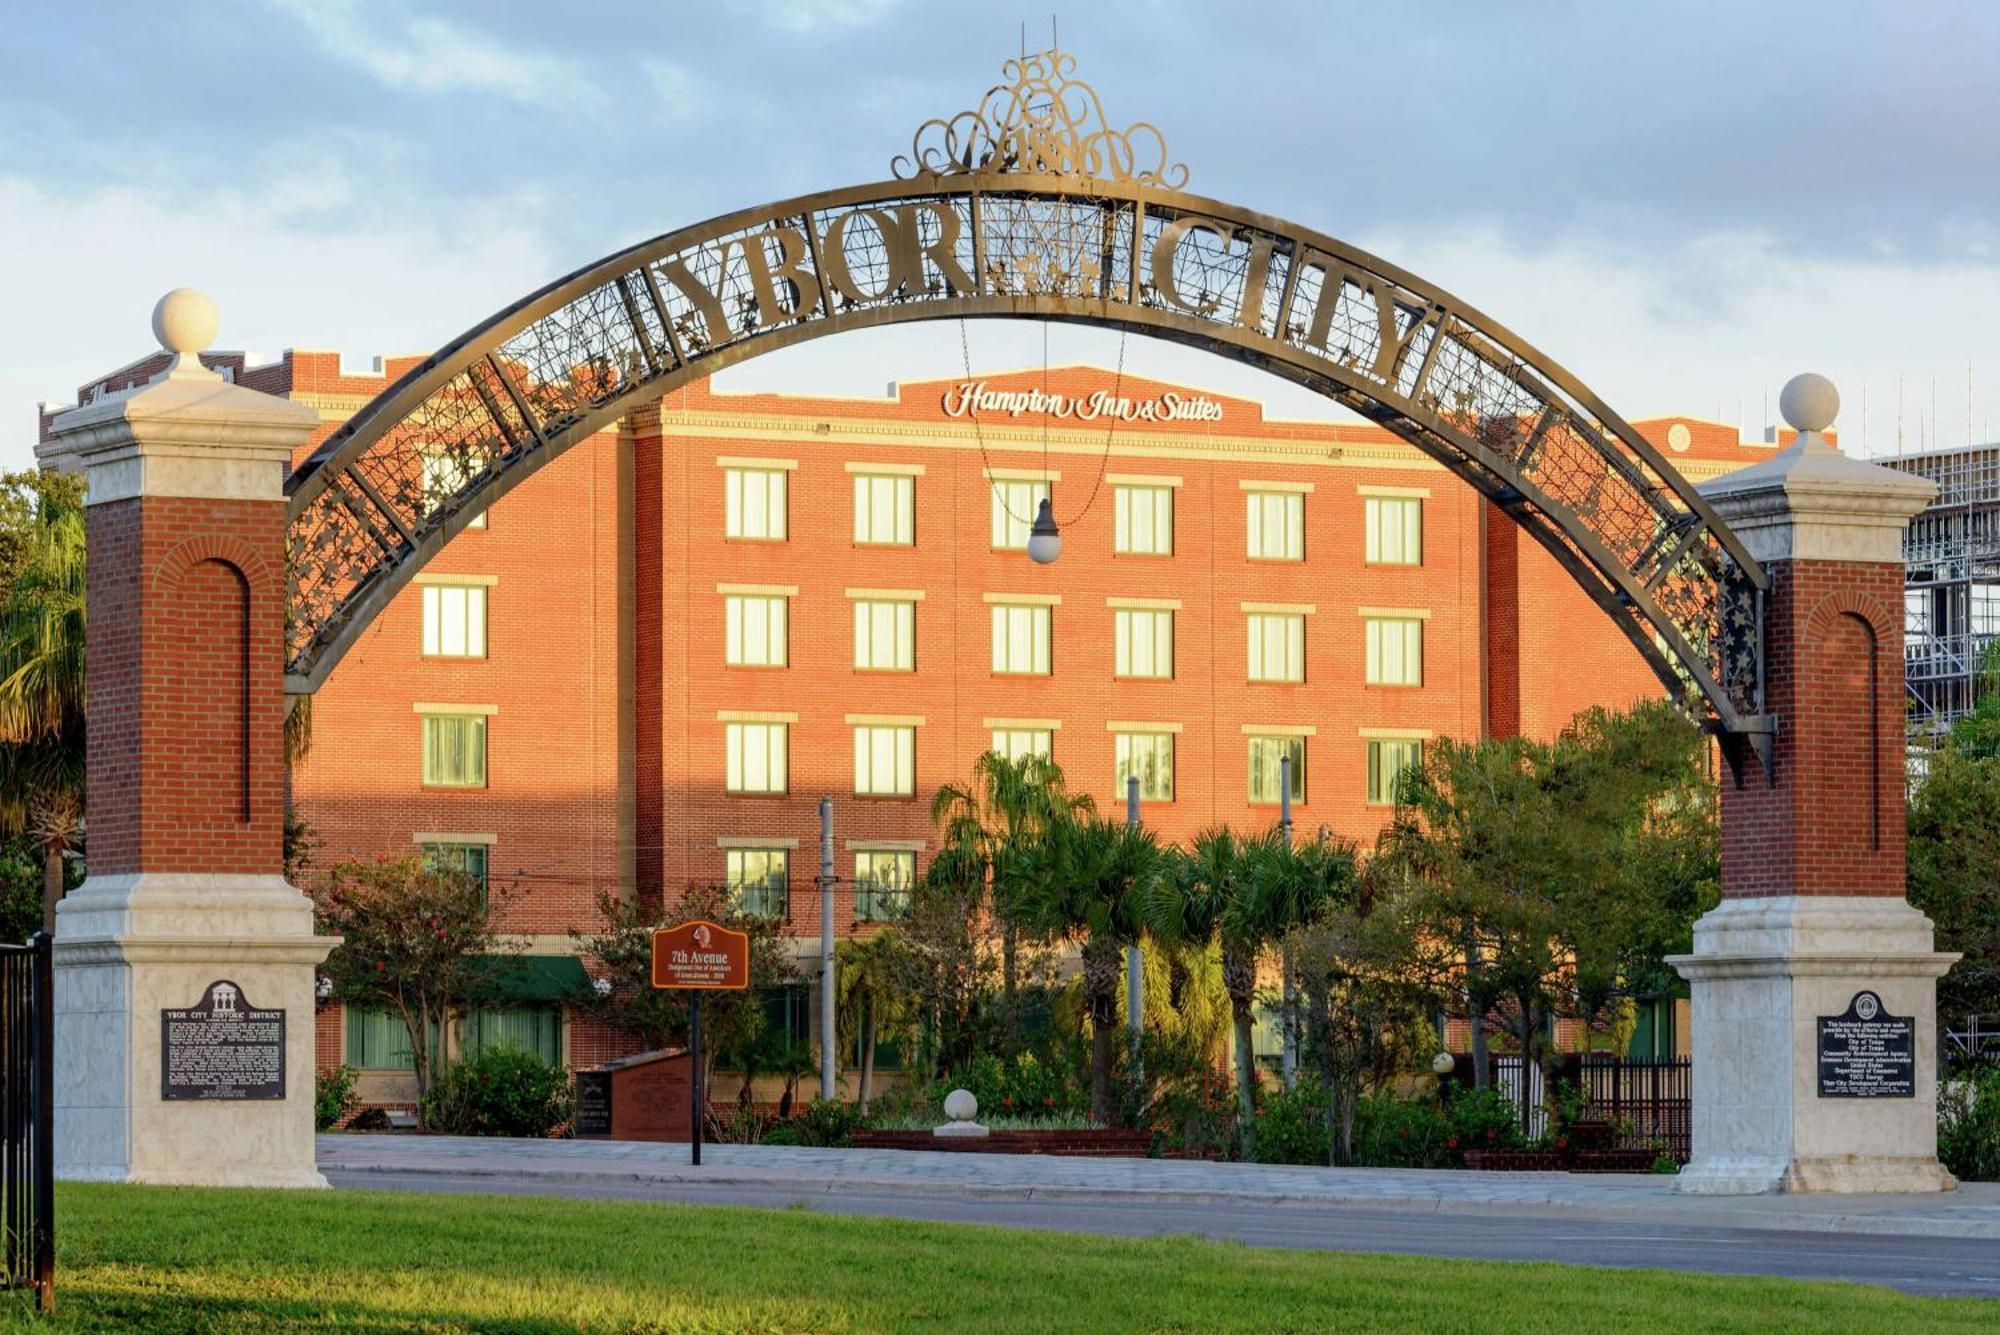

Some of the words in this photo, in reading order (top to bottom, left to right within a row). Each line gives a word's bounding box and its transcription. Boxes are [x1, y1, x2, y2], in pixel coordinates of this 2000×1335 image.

[654, 203, 979, 346] YBOR
[1151, 216, 1443, 384] CITY
[944, 382, 1074, 417] Hampton
[1076, 390, 1140, 420] Inn
[1141, 403, 1154, 419] &
[1154, 392, 1222, 422] Suites
[672, 950, 687, 963] 7th
[691, 951, 728, 964] Avenue
